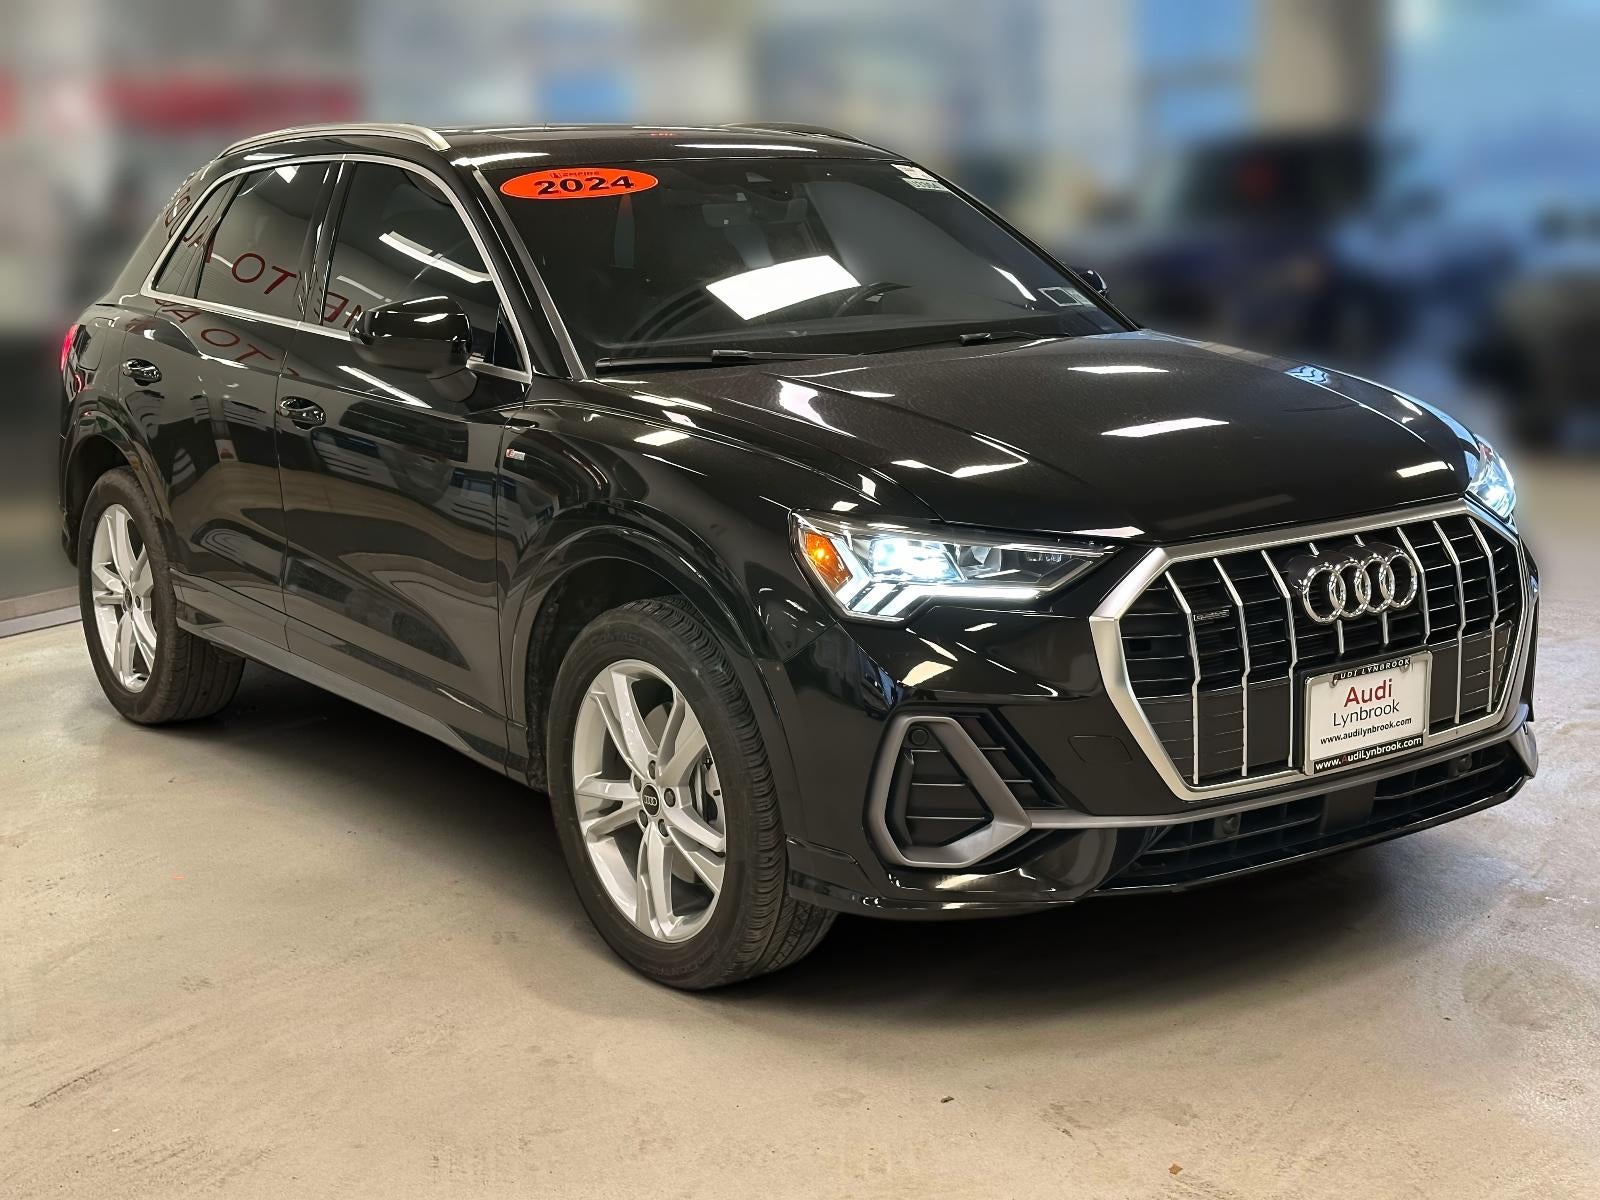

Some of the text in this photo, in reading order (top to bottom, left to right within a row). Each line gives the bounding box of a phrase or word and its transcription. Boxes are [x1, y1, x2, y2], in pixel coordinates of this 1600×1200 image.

[533, 175, 635, 196] 2024
[1361, 658, 1411, 675] LYNBROOK
[1343, 678, 1393, 708] Audi
[1333, 699, 1400, 728] Lynbrook
[1319, 717, 1412, 745] www.audilynbrook.com
[1315, 737, 1422, 771] www.AudiLynbrook.com
